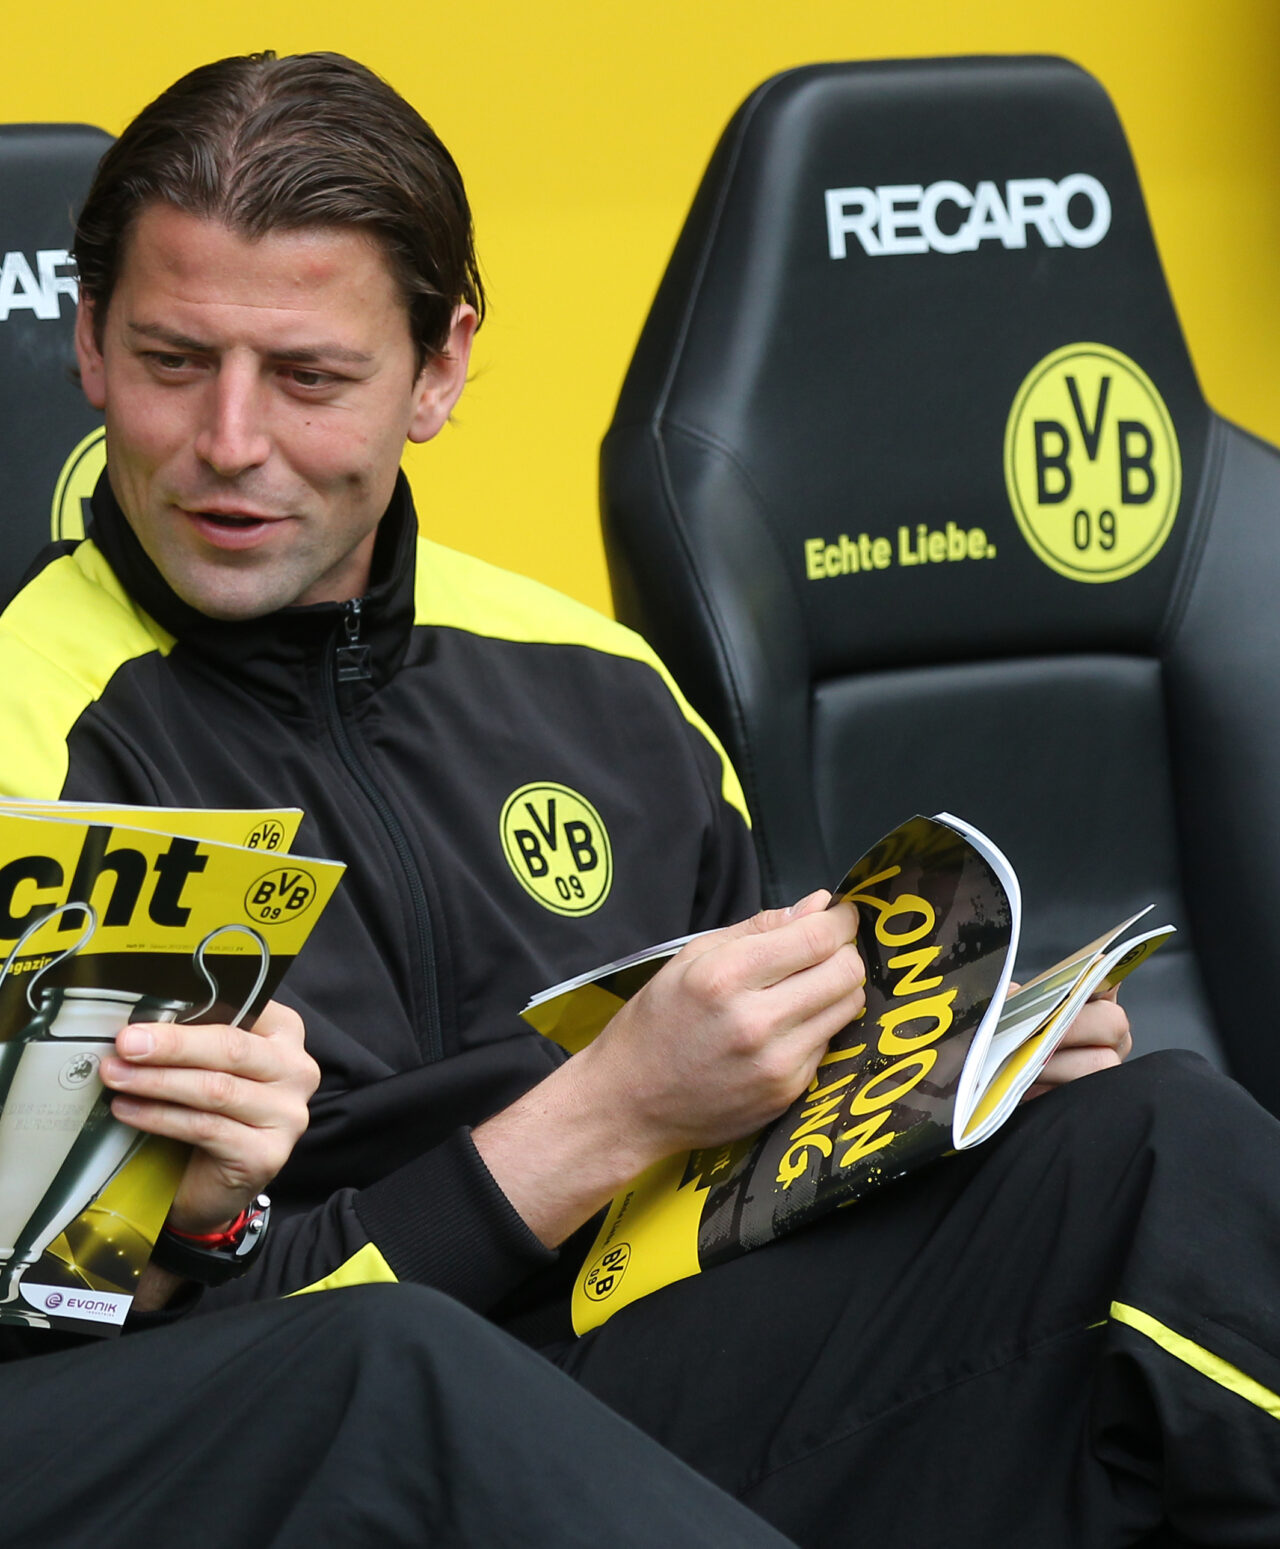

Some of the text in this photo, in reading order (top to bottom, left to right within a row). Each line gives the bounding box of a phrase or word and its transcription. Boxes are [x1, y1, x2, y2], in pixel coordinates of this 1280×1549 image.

[824, 173, 1112, 260] RECARO
[1033, 375, 1158, 506] BVB
[804, 521, 997, 580] Echte Liebe.
[1072, 509, 1117, 552] 09
[247, 823, 281, 850] BVB
[514, 798, 599, 878] BVB
[252, 872, 310, 910] BVB
[554, 874, 586, 901] 09
[260, 905, 282, 920] 09
[596, 1248, 627, 1295] BVB
[66, 1298, 118, 1313] EVONIK
